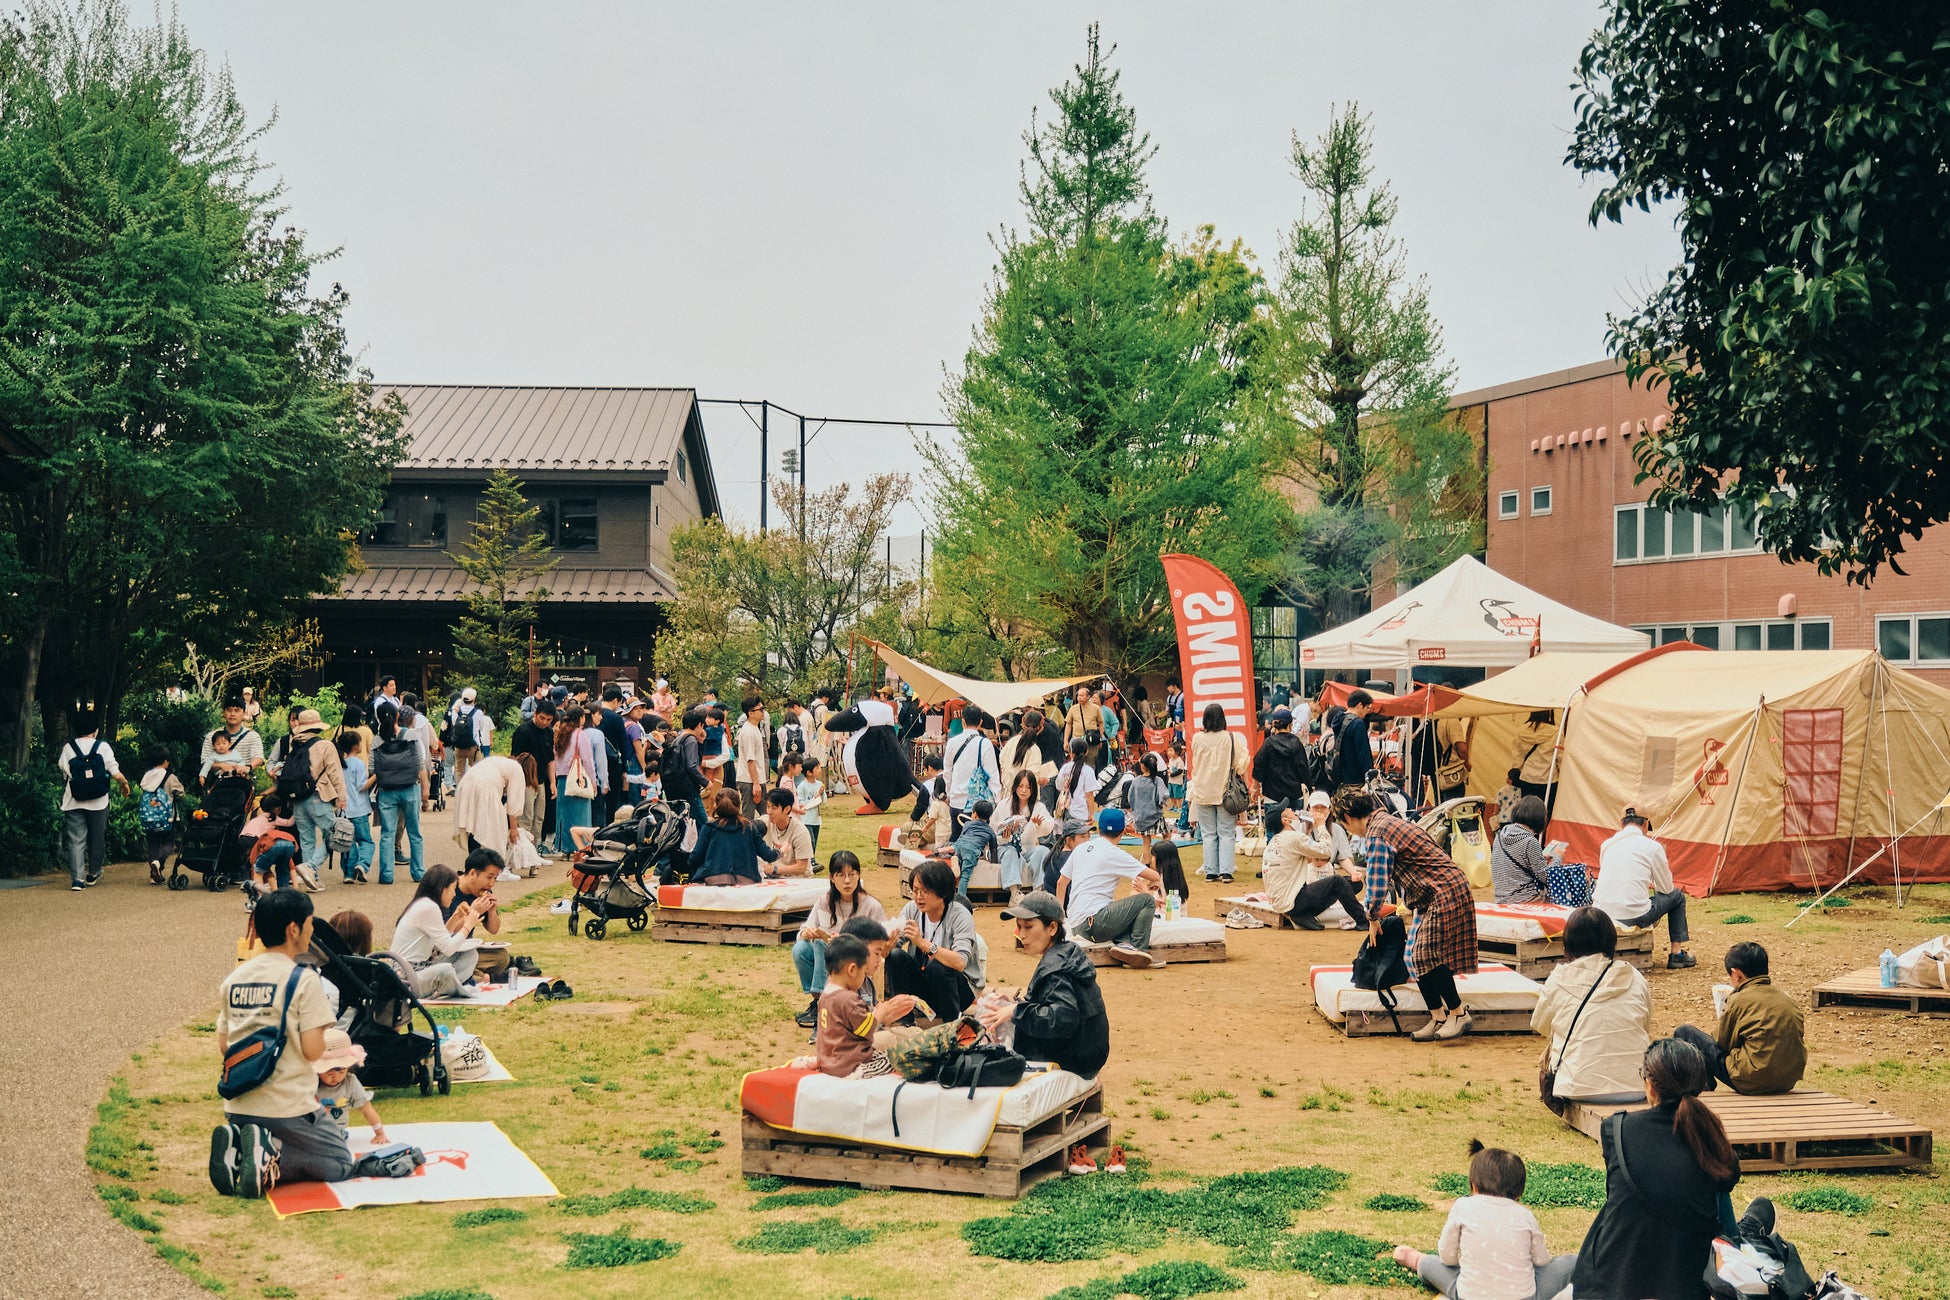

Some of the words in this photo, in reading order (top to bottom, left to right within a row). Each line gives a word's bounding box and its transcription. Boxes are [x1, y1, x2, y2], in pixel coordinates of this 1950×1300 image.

[1419, 649, 1445, 659] CHUMS
[231, 986, 274, 1006] CHUMS
[463, 1050, 486, 1066] FAC
